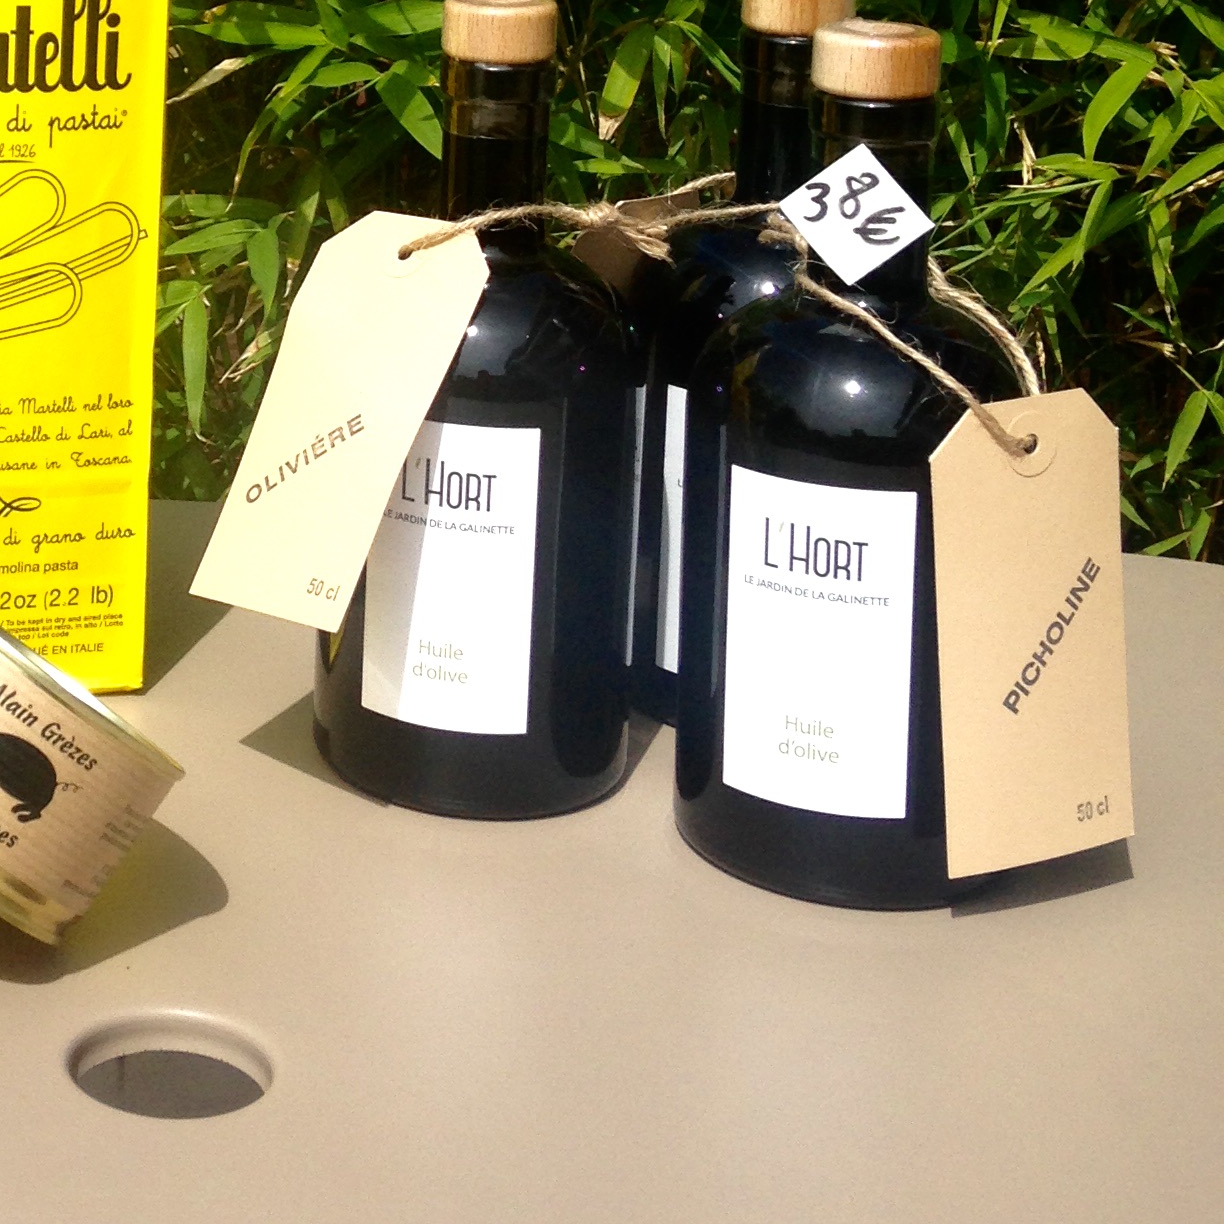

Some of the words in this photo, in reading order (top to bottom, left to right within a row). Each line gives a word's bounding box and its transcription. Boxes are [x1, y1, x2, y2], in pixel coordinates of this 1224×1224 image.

[7, 104, 32, 132] di
[8, 143, 36, 159] 1926
[18, 396, 76, 415] Martelli
[83, 396, 103, 412] nel
[107, 393, 134, 410] loro
[56, 425, 71, 441] di
[77, 423, 114, 441] Lari,
[119, 420, 133, 437] al
[45, 457, 61, 470] in
[245, 414, 365, 504] OLIVIÉRE
[401, 457, 497, 512] L'HORT
[394, 511, 427, 526] JARDIN
[429, 519, 443, 530] DE
[445, 521, 457, 530] LA
[459, 523, 515, 535] GALINETTE
[3, 527, 21, 545] di
[32, 531, 85, 553] grano
[95, 523, 136, 543] duro
[764, 517, 869, 582] L'HORT
[43, 560, 79, 574] pasta
[44, 587, 80, 611] (2.2
[91, 584, 114, 608] lb)
[306, 577, 324, 597] 50
[325, 585, 341, 602] cl
[744, 574, 754, 584] LE
[756, 578, 792, 595] JARDIN
[794, 587, 809, 598] DE
[811, 590, 825, 601] LA
[827, 592, 890, 607] GALINETTE
[52, 645, 67, 655] EN
[70, 642, 104, 654] ITALIE
[1002, 557, 1101, 715] PICHOLINE
[419, 639, 464, 661] Huile
[412, 661, 468, 684] d'olive
[785, 714, 834, 739] Huile
[40, 722, 98, 772] Grèzes
[778, 738, 839, 764] d'olive
[1077, 801, 1093, 822] 50
[1096, 795, 1109, 816] cl
